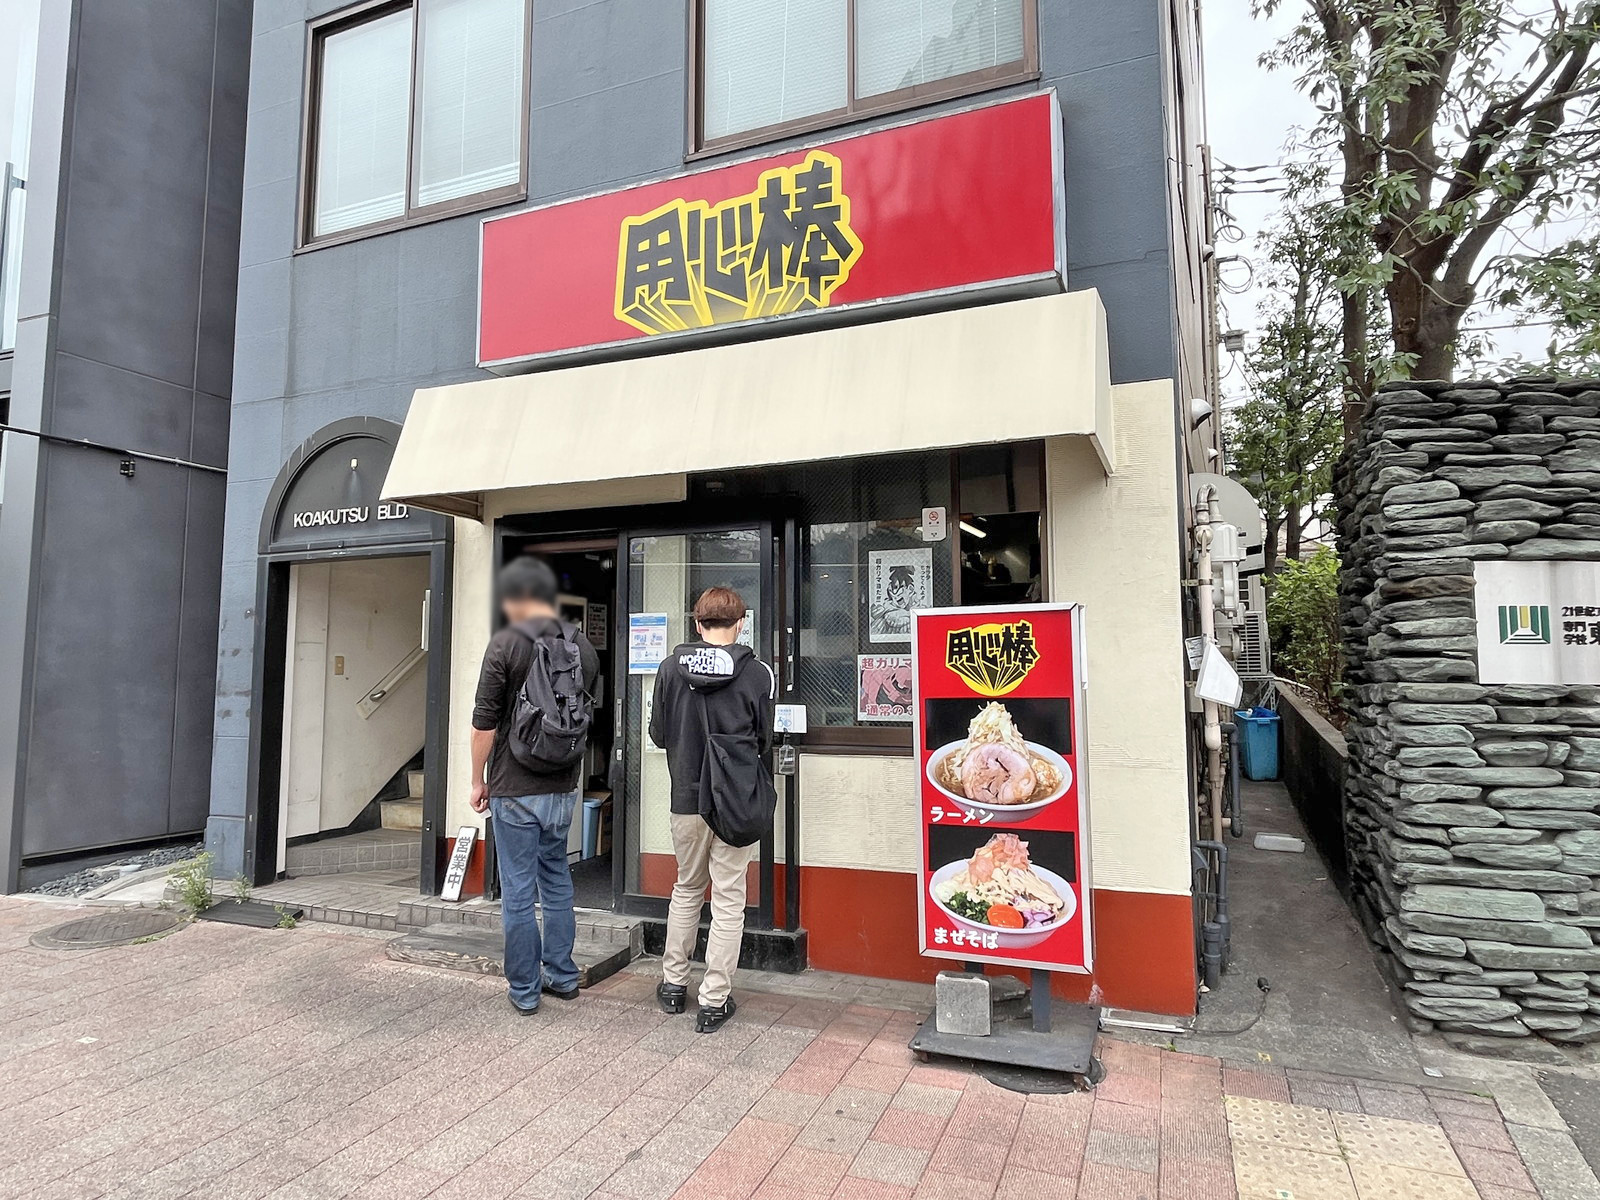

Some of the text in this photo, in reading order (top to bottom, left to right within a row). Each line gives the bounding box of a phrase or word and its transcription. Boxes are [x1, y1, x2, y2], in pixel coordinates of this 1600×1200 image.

[618, 156, 858, 312] 用心棒
[293, 503, 409, 528] KOAKUTSU BLD.
[679, 655, 715, 666] NORTH
[695, 647, 716, 657] THE
[946, 621, 1040, 678] 用心棒
[688, 664, 714, 674] FACE
[930, 806, 995, 825] ラーメン
[447, 836, 471, 890] 営業中
[934, 926, 999, 949] まぜそば
